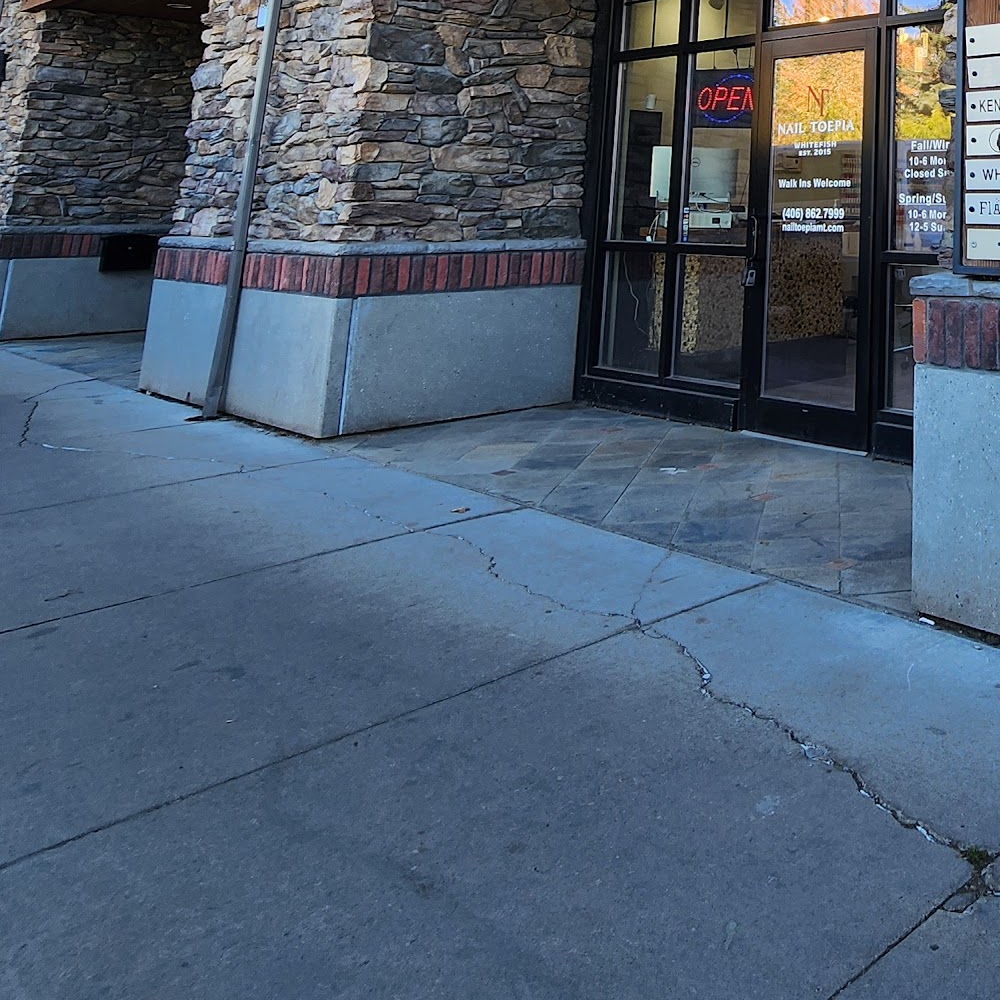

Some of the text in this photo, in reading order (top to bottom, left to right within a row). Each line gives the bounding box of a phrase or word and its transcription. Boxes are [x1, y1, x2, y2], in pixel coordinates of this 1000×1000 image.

[778, 119, 855, 135] NAIL TOEPIA
[794, 140, 837, 149] WHITEFISH
[813, 148, 832, 156] 2015
[908, 156, 928, 166] 10-6
[904, 168, 936, 178] Closed
[778, 178, 851, 189] Walk Ins Welcome
[782, 207, 845, 221] (406) 862.7999
[907, 209, 927, 219] 10-6
[782, 222, 844, 234] nailtoepiamt.com
[909, 222, 946, 232] 12-5 Su
